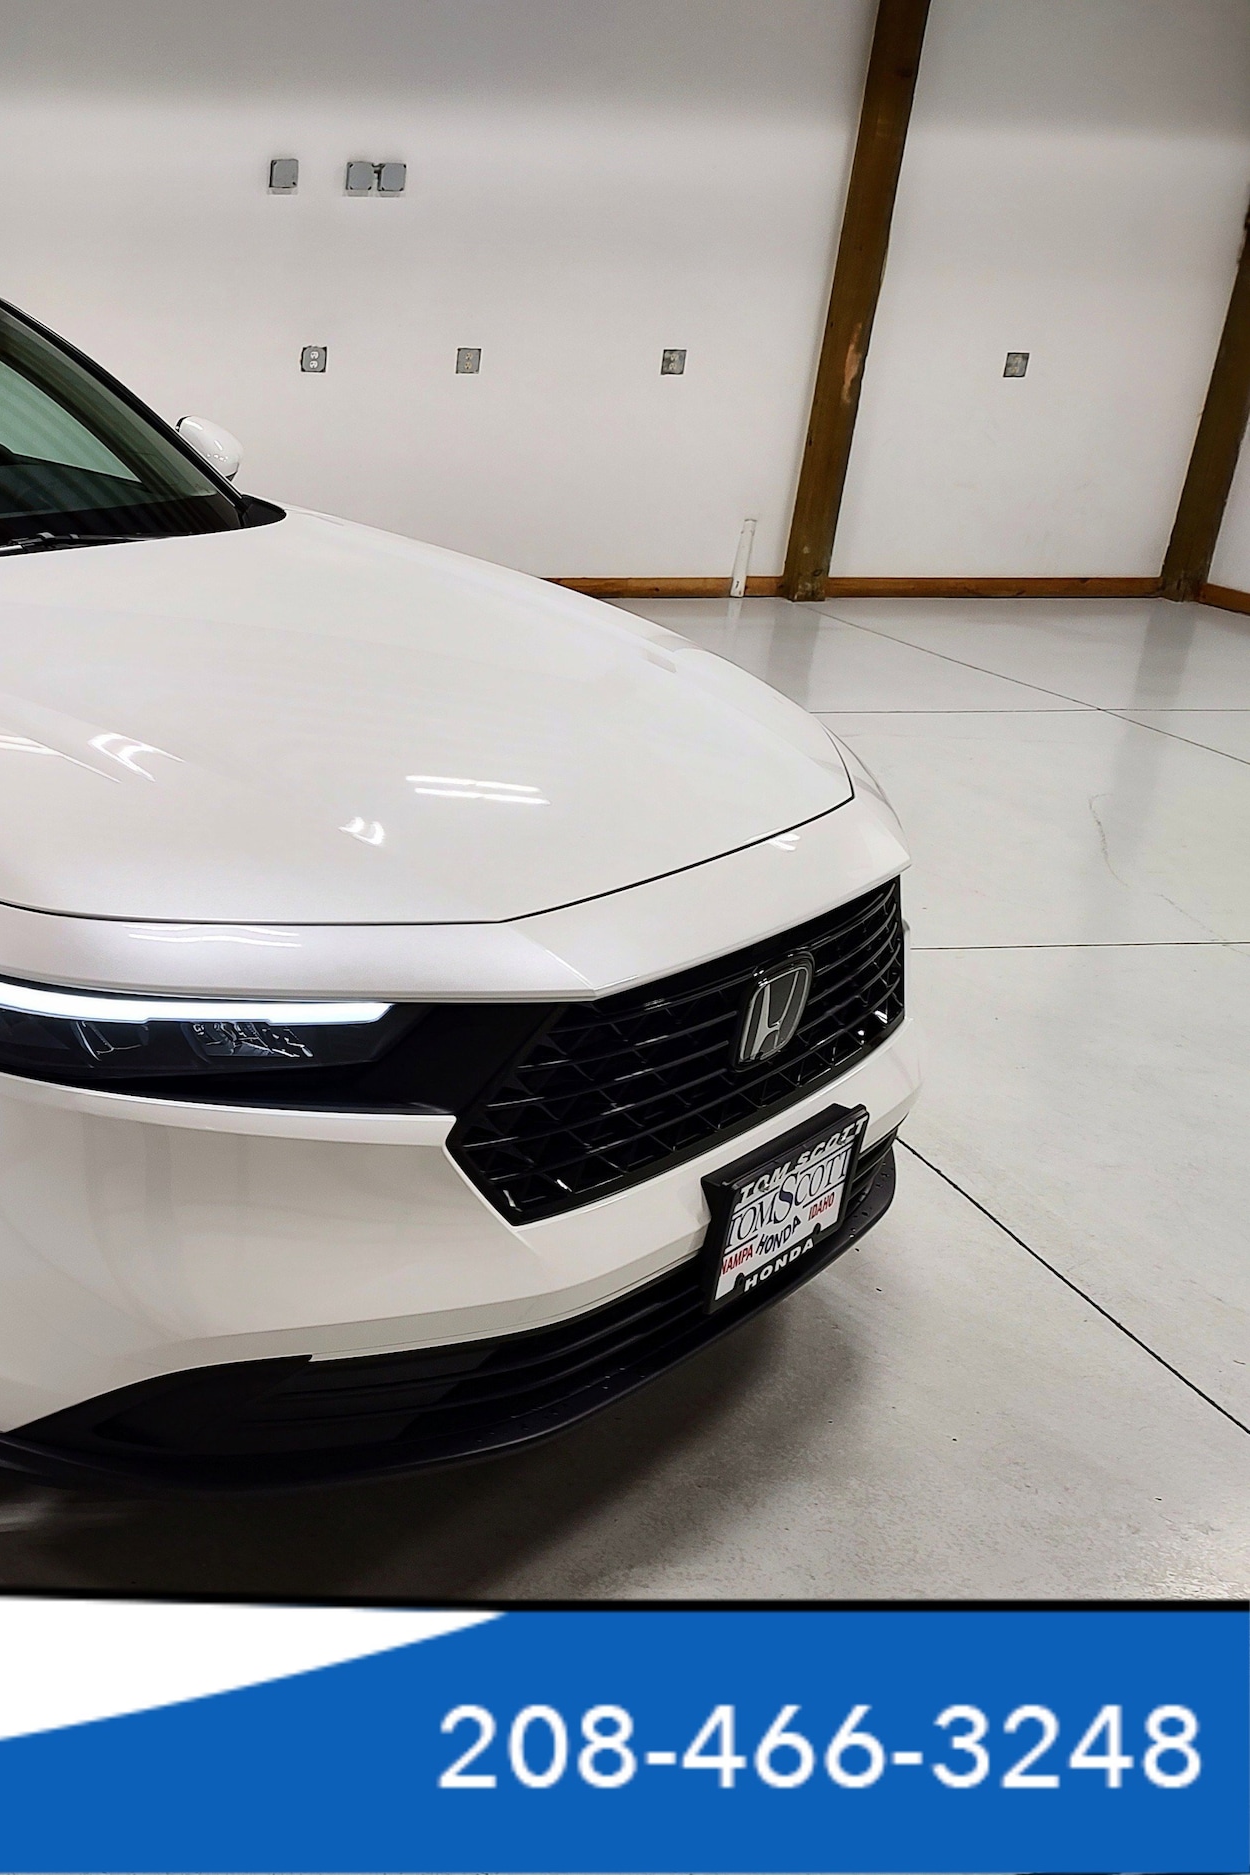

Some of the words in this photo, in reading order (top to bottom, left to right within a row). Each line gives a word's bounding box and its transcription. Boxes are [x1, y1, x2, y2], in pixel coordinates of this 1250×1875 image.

[740, 1162, 790, 1198] TOM
[797, 1116, 868, 1166] SCOTT
[808, 1192, 835, 1221] IDAHO
[756, 1216, 801, 1255] HONDA
[720, 1244, 753, 1275] NAMPA
[744, 1238, 814, 1292] HONDA
